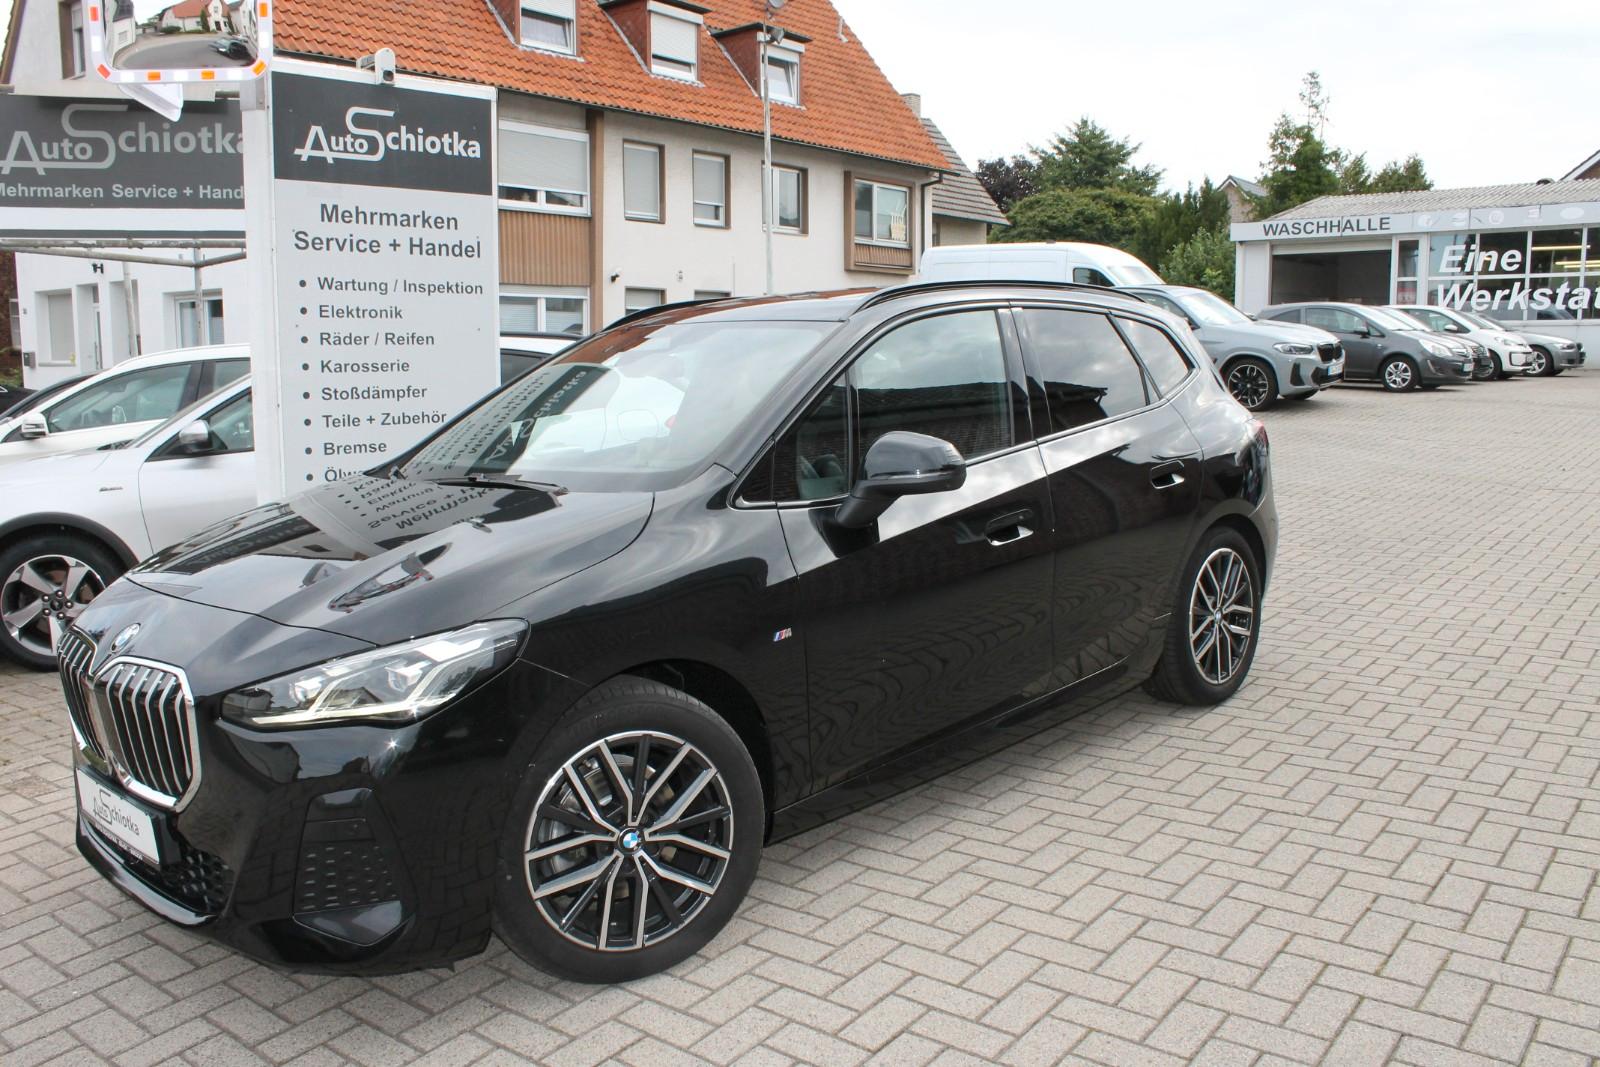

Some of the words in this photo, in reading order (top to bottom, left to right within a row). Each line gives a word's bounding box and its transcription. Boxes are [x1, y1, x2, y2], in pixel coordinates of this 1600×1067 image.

[294, 125, 368, 164] Auto
[345, 106, 481, 162] Schiotka
[112, 184, 178, 199] Service
[183, 187, 194, 197] +
[320, 203, 458, 231] Mehrmarken
[1262, 216, 1392, 237] WASCHHALLE
[293, 231, 381, 254] Service
[388, 239, 401, 252] +
[408, 237, 481, 259] Handel
[1438, 243, 1523, 273] Eine
[317, 276, 389, 296] Wartung
[403, 279, 484, 296] Inspektion
[318, 304, 404, 320] Elektronik
[319, 332, 370, 346] Räder
[384, 332, 435, 346] Reifen
[320, 359, 411, 374] Karosserie
[321, 385, 428, 402] Stoßdämpfer
[322, 414, 361, 429] Teile
[366, 415, 376, 425] +
[380, 410, 448, 427] Zubehör
[323, 440, 388, 456] Bremse
